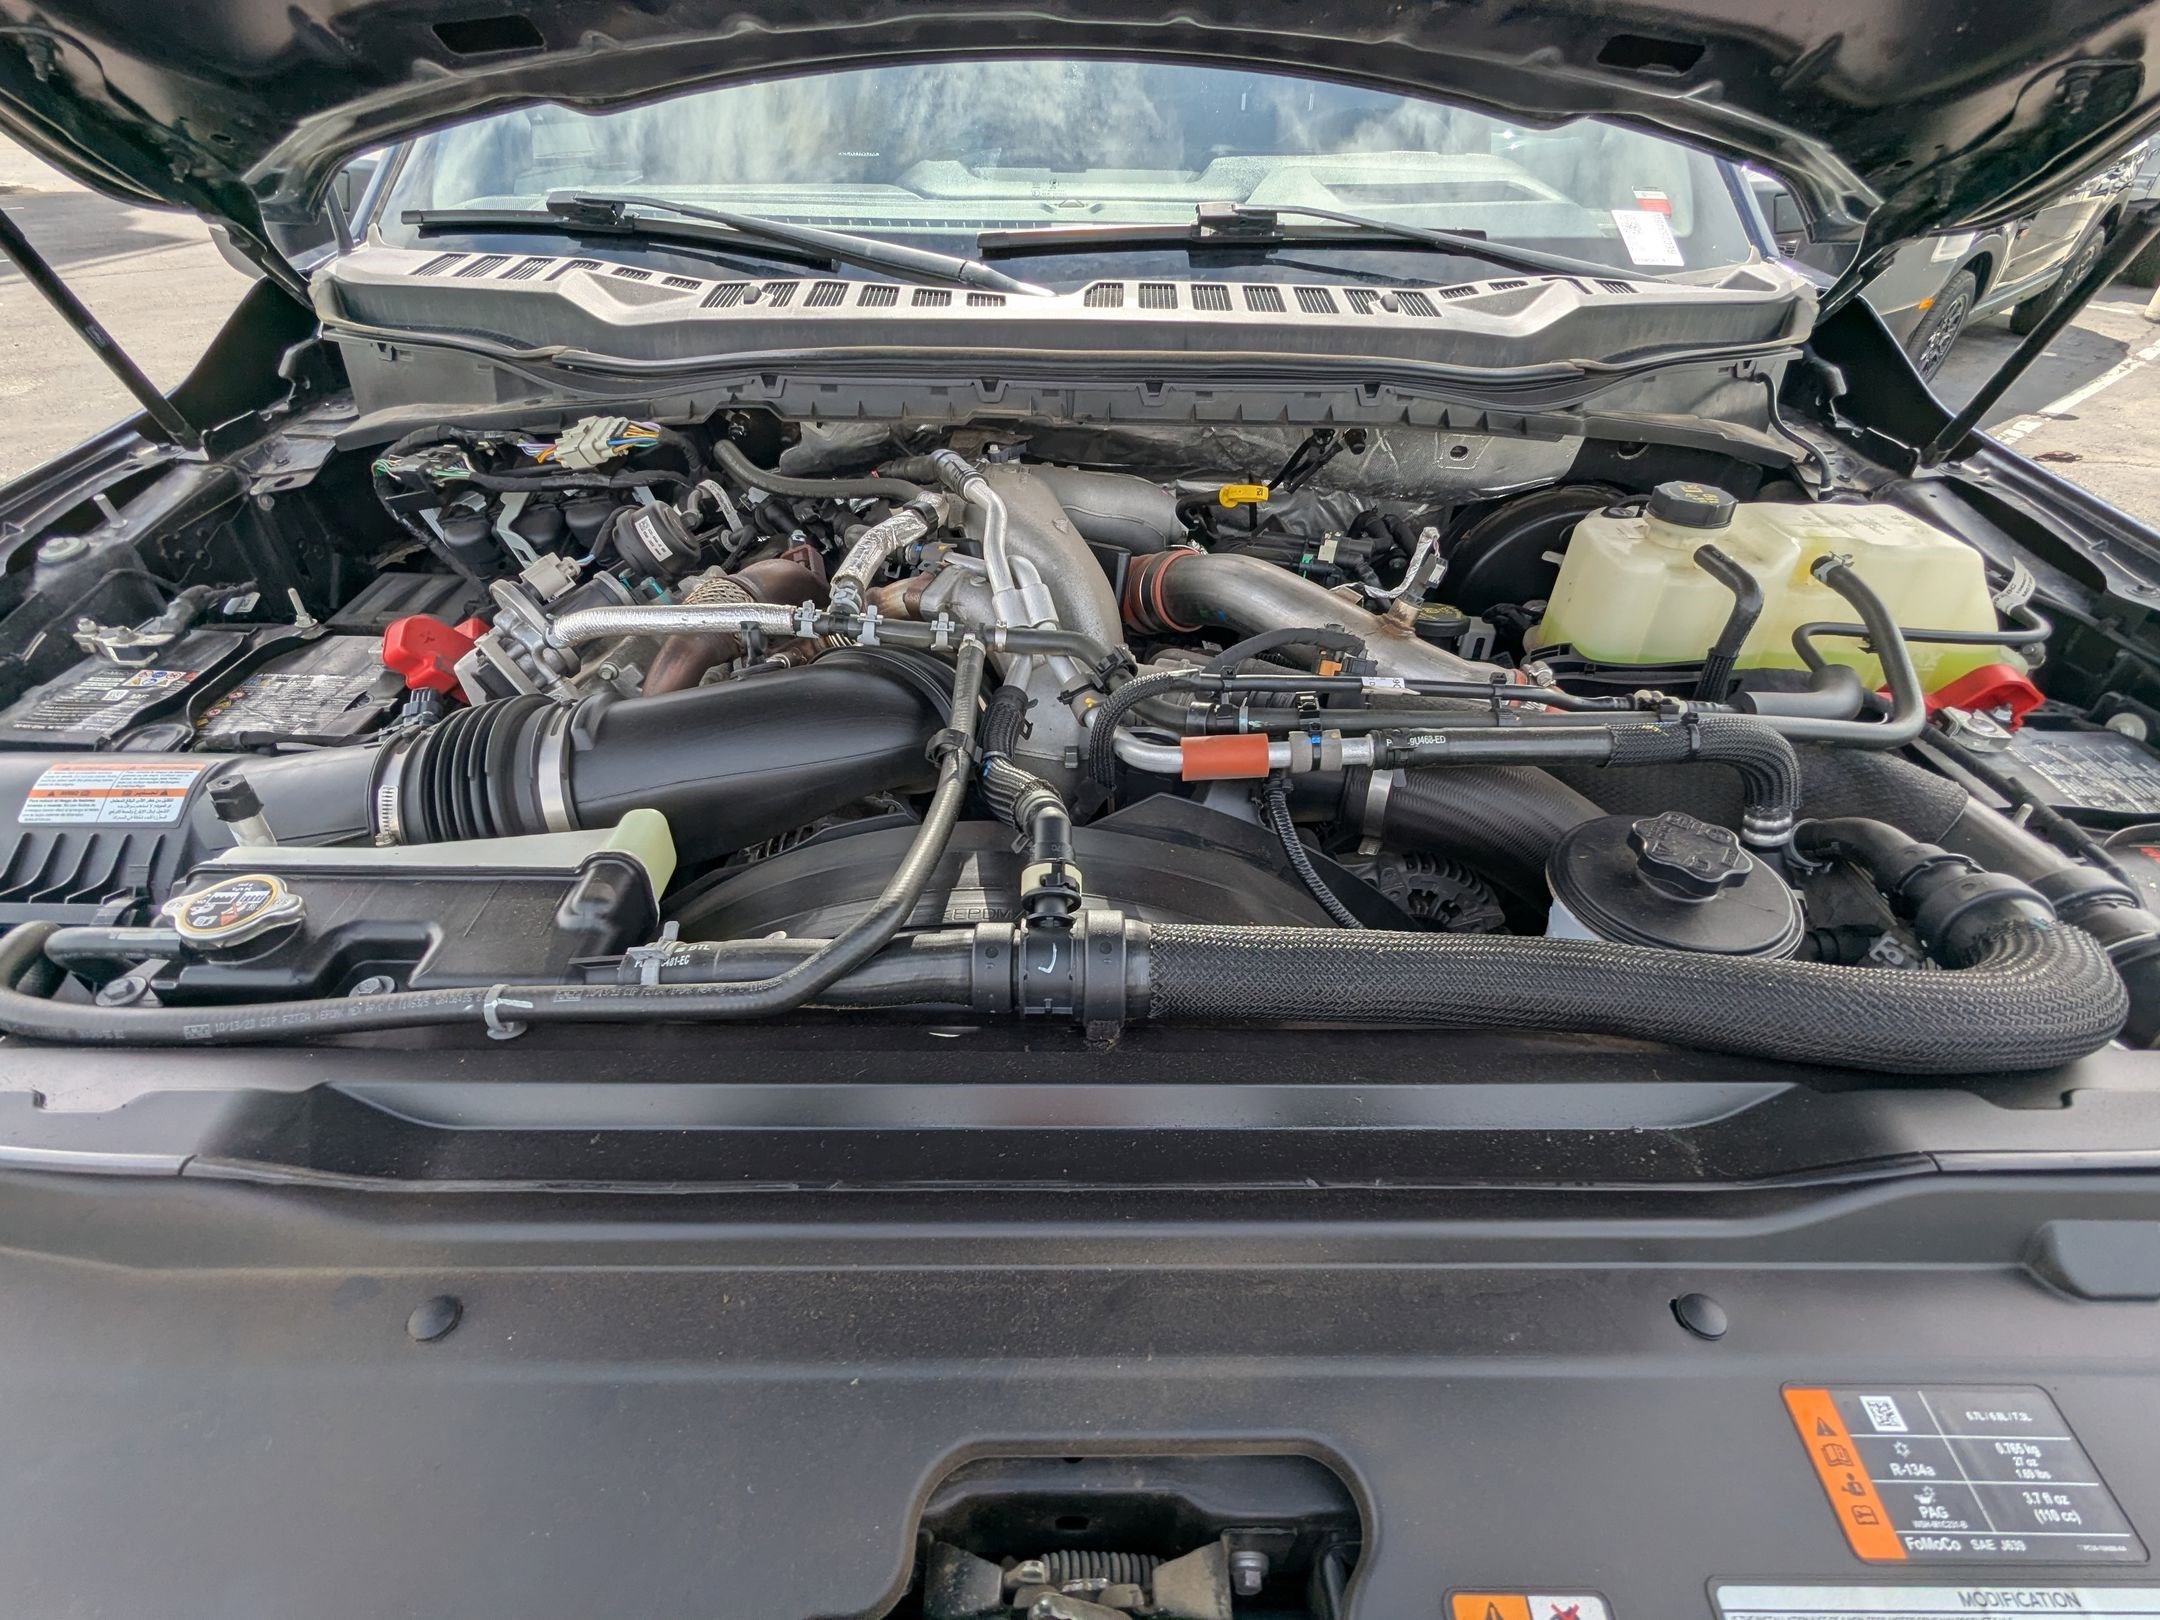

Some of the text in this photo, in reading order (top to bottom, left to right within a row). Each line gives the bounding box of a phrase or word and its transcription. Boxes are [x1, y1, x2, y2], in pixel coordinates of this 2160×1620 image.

[2023, 1443, 2042, 1458] kg
[1889, 1462, 1936, 1476] R-134a
[2053, 1494, 2071, 1505] oz
[1918, 1505, 1950, 1519] PAG
[2061, 1509, 2083, 1525] cc)
[1904, 1536, 1962, 1551] FoMoCo
[1970, 1539, 1997, 1551] SAE
[1958, 1591, 2083, 1608] MODIFICATION
